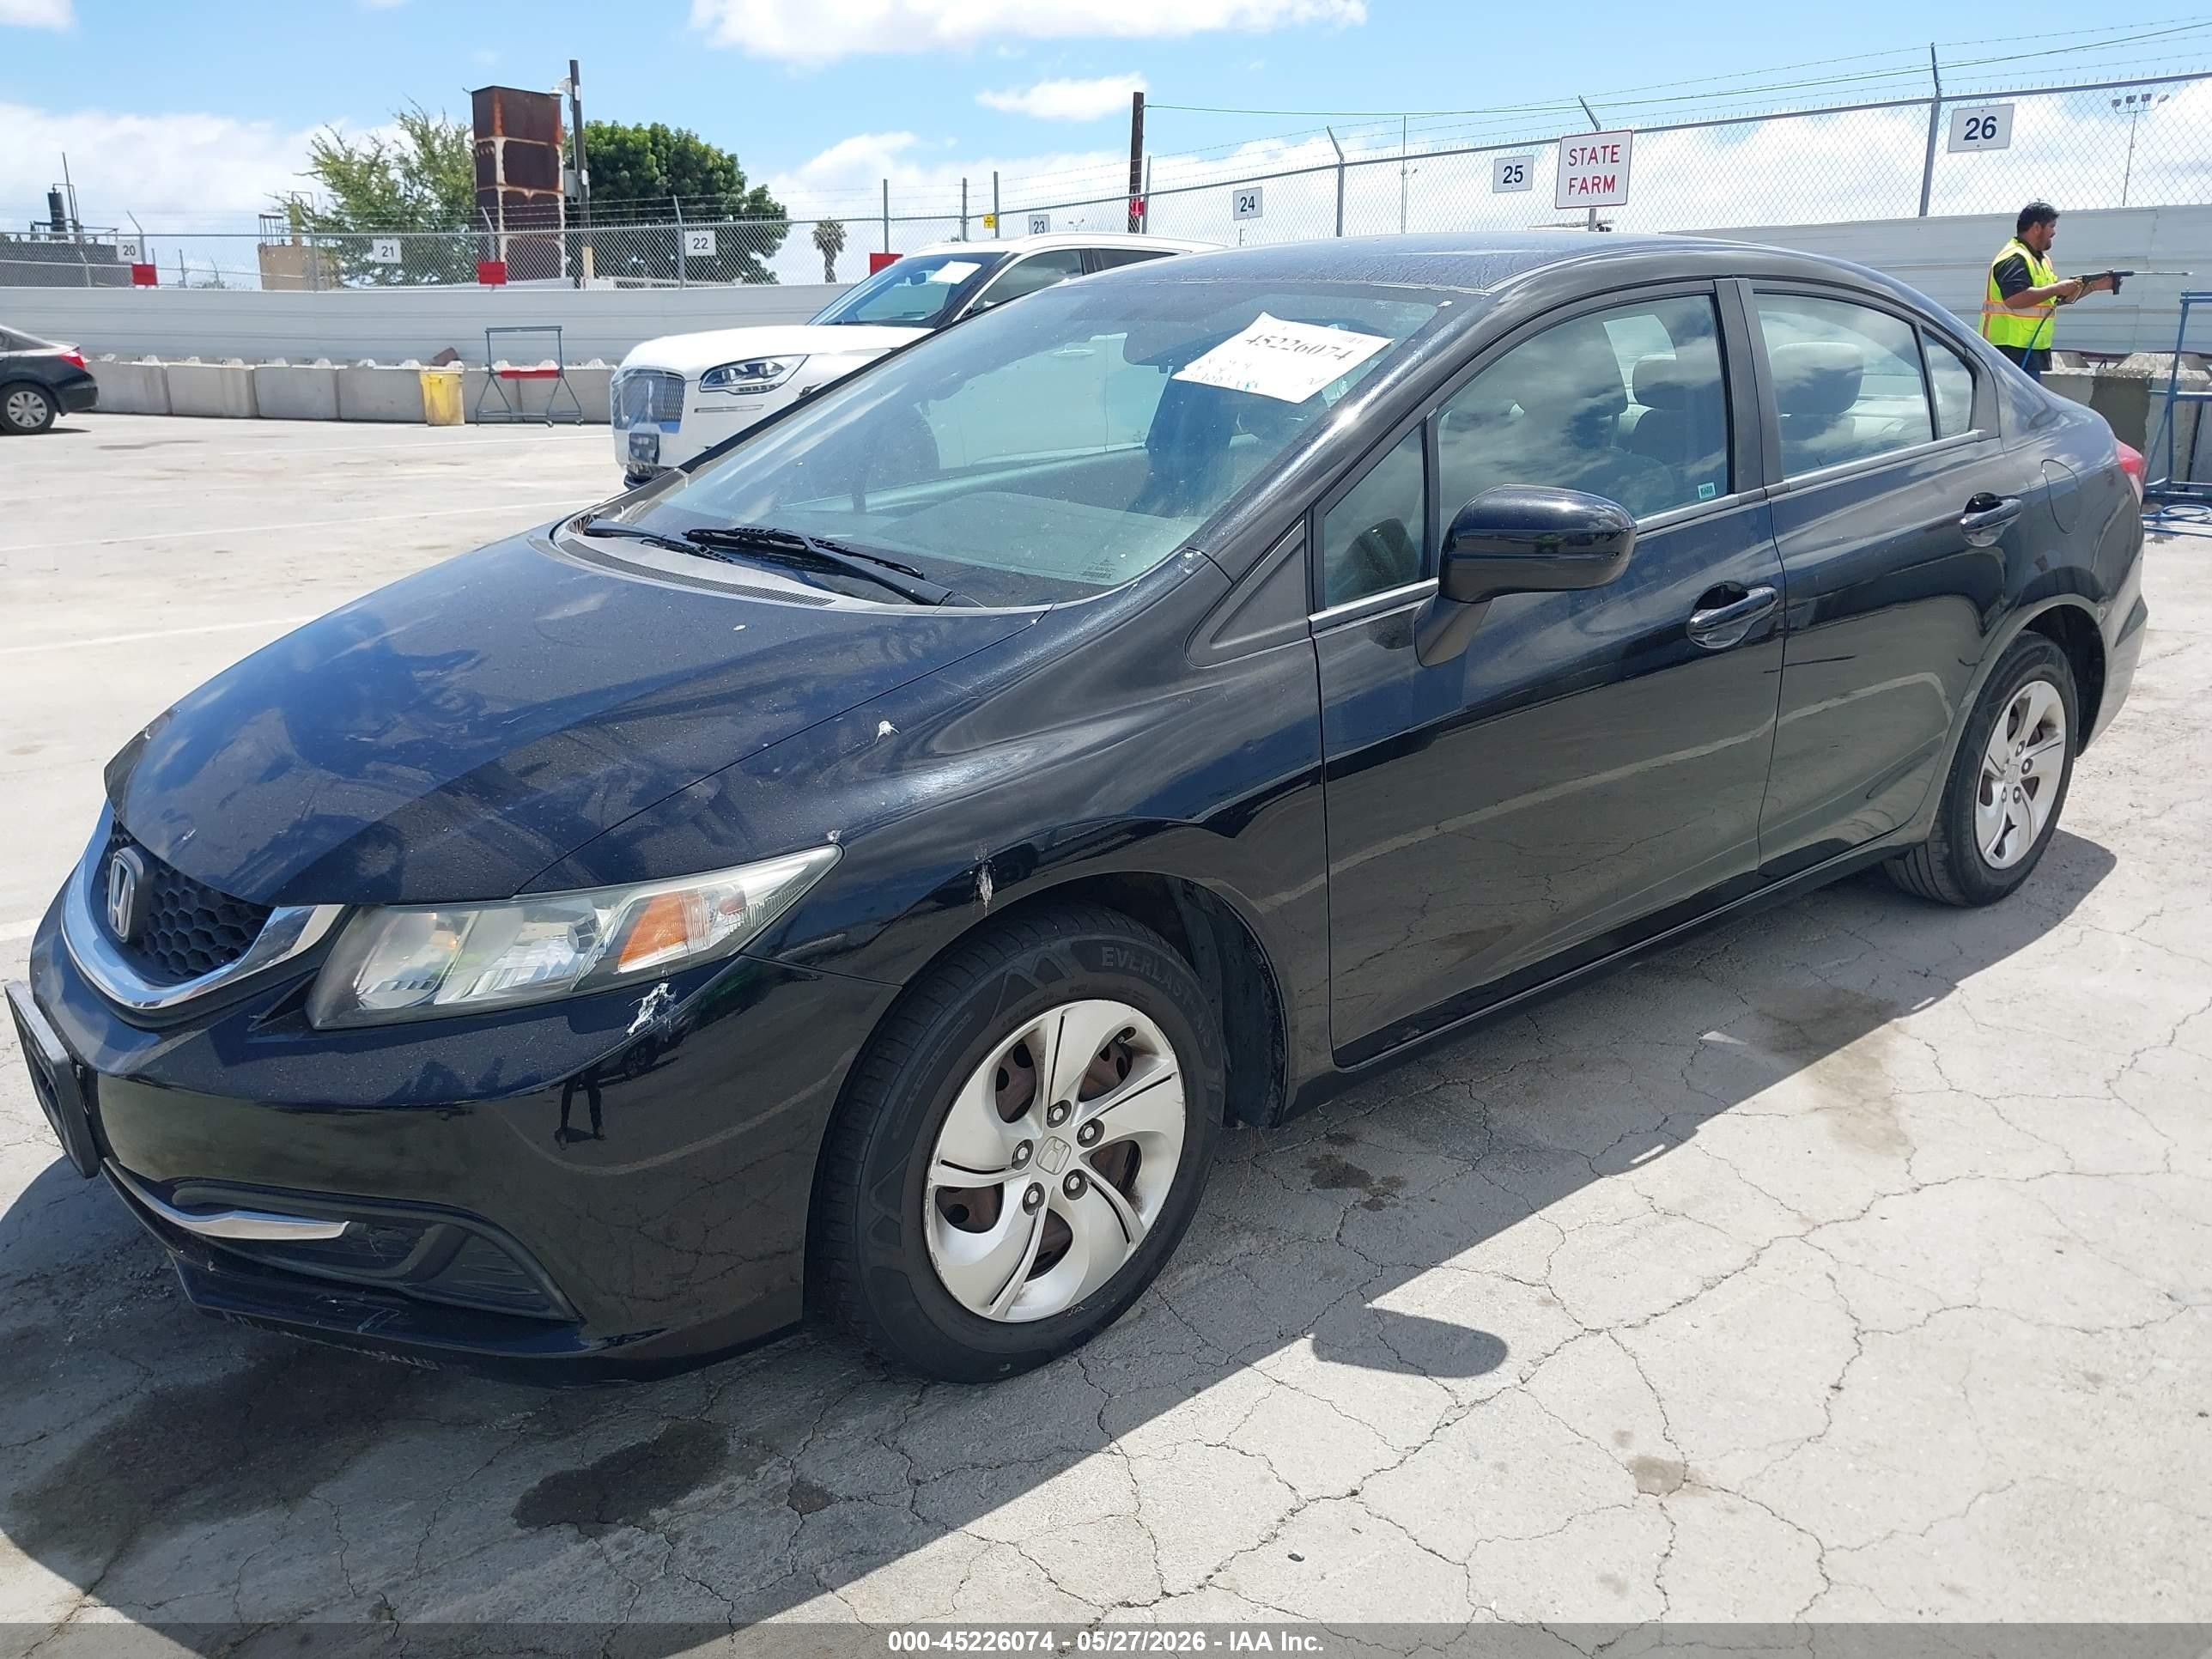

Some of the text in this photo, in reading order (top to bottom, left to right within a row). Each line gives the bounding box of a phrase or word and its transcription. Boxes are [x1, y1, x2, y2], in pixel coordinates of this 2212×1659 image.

[1963, 115, 1997, 141] 26
[1568, 143, 1621, 167] STATE
[1502, 164, 1524, 185] 25
[1568, 173, 1616, 197] FARM
[1240, 195, 1255, 213] 24
[1033, 220, 1046, 234] 23
[123, 244, 136, 256] 20
[381, 245, 394, 258] 21
[693, 237, 708, 250] 22
[1245, 333, 1355, 362] 45226074
